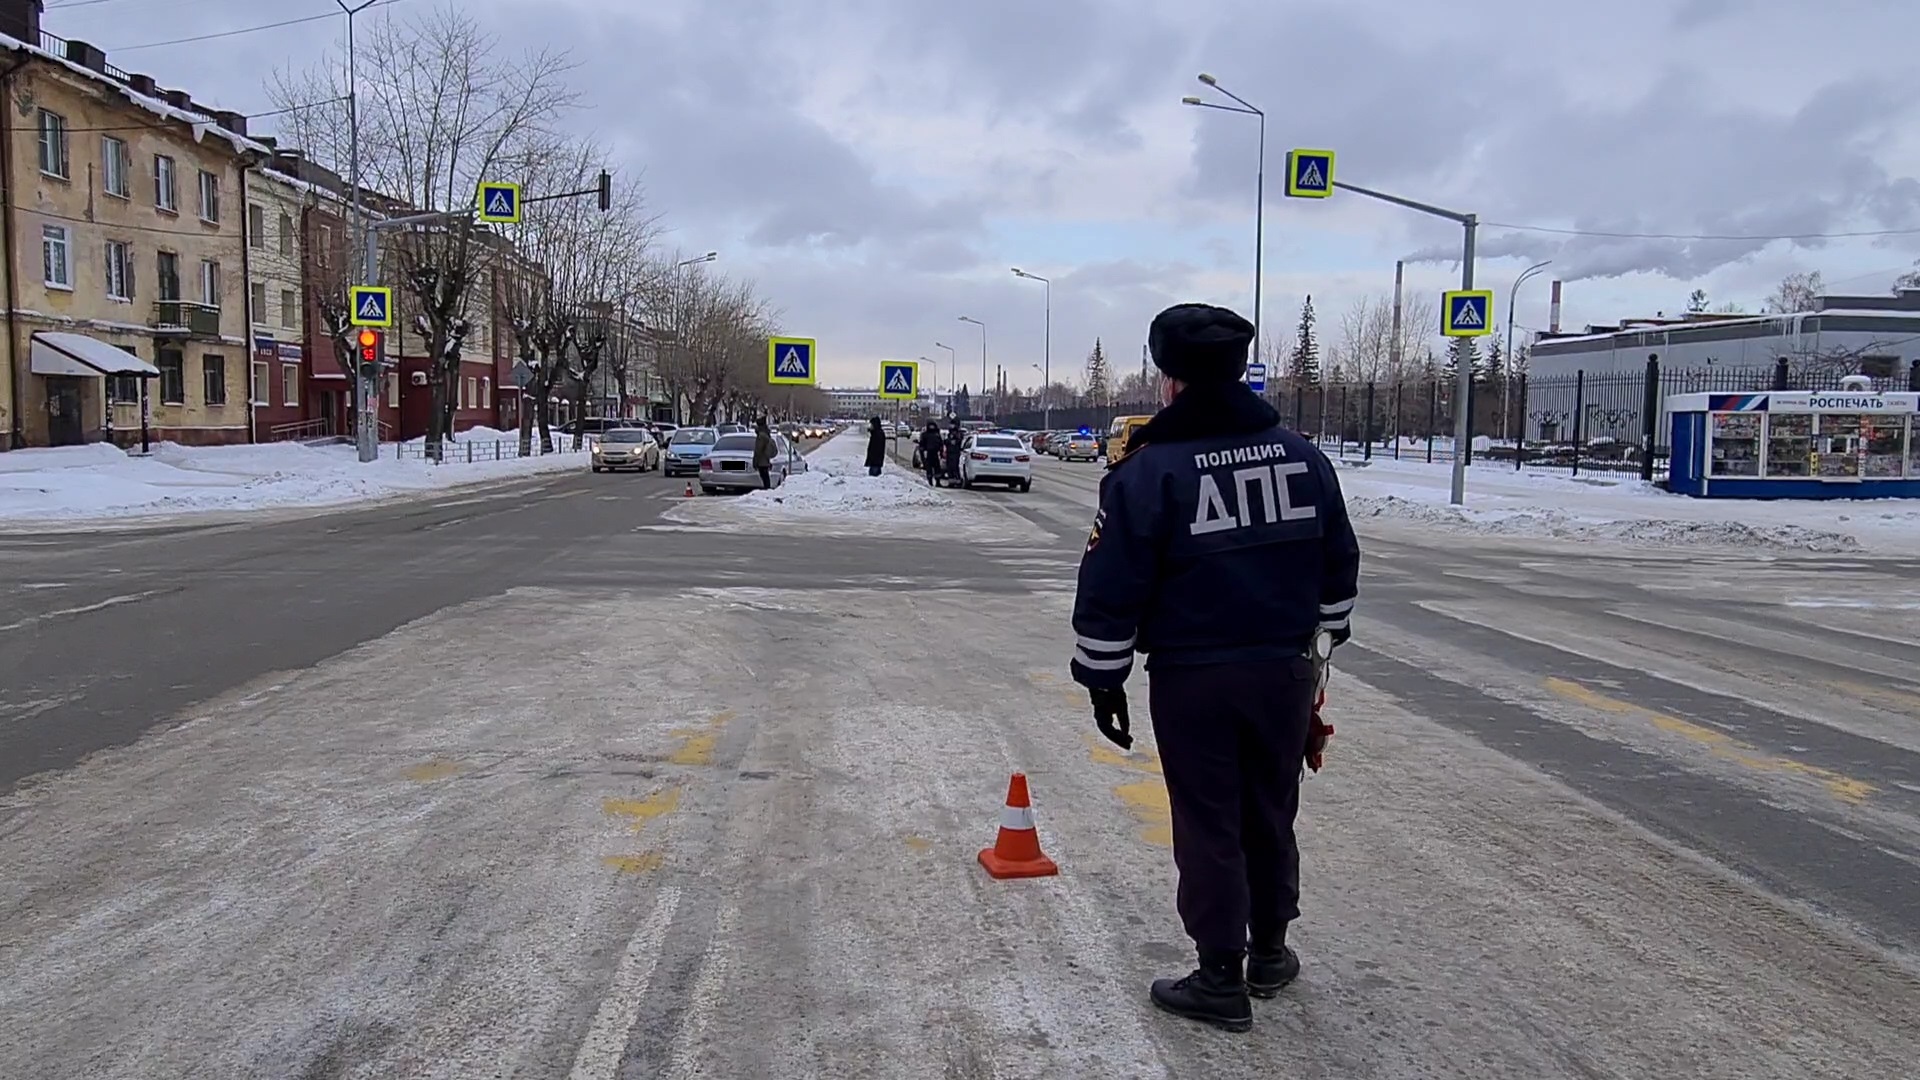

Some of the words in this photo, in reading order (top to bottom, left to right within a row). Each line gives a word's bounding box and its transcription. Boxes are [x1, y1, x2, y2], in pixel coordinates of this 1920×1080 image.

[363, 349, 374, 360] 52
[1809, 398, 1883, 409] РОСПЕЧАТЬ
[1194, 444, 1286, 469] ПОЛИЦИЯ
[1189, 462, 1316, 535] ДПС
